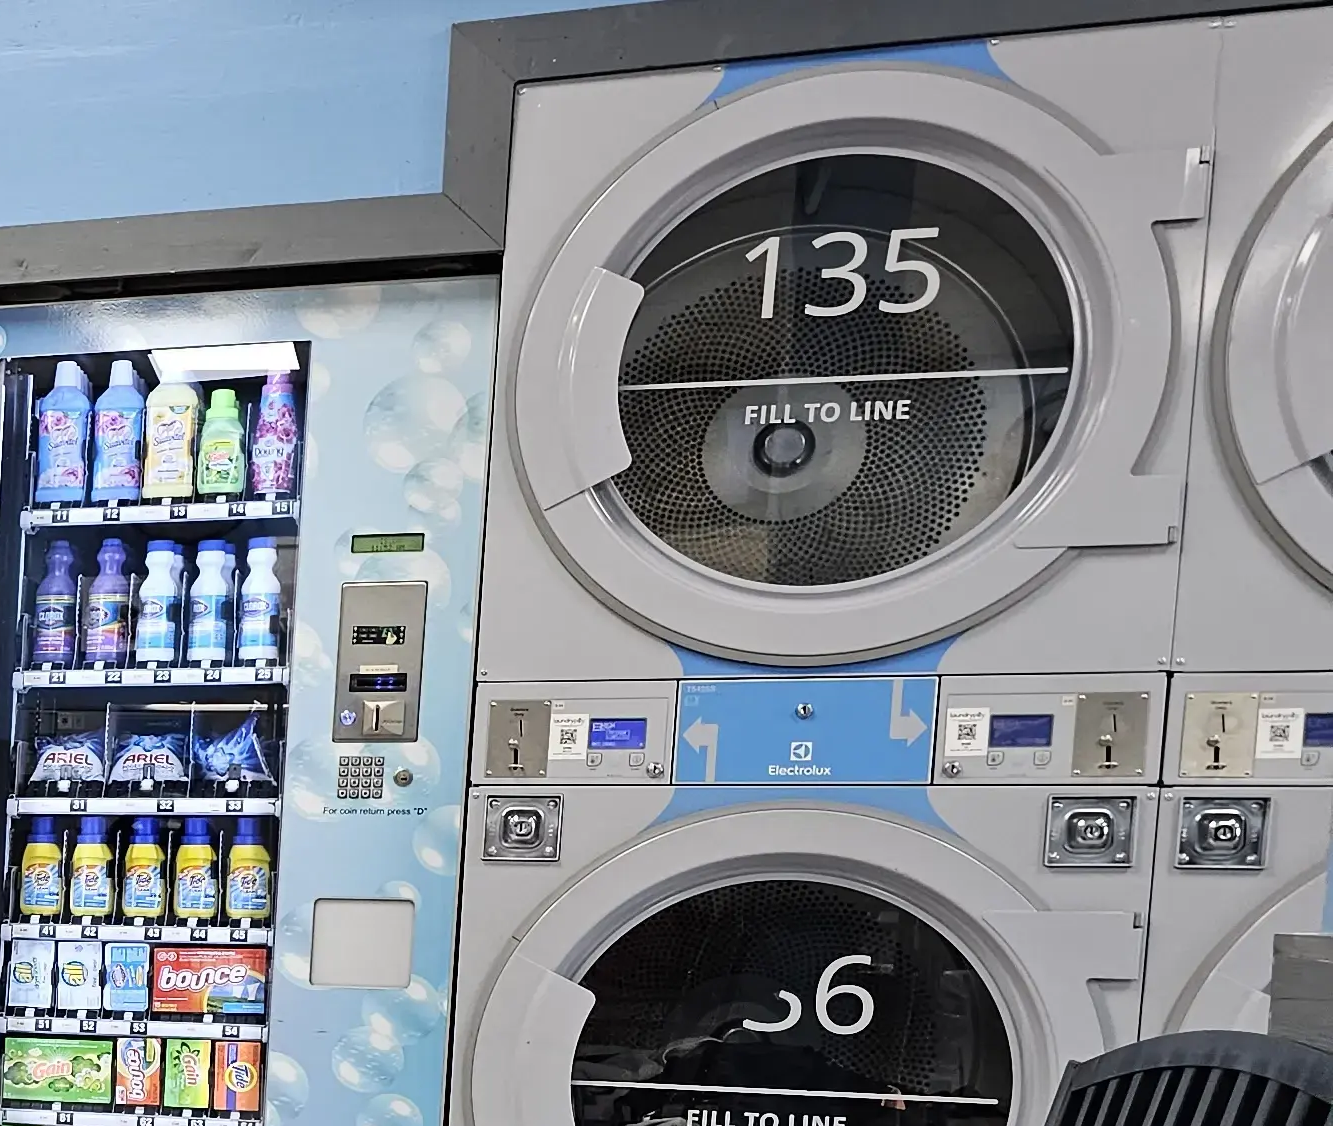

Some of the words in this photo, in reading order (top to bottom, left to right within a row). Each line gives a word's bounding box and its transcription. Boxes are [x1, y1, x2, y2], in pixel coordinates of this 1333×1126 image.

[744, 227, 942, 319] 135
[744, 403, 797, 425] FILL
[804, 402, 841, 423] TO
[850, 400, 912, 421] LINE
[173, 507, 186, 518] 13
[231, 505, 245, 516] 14
[274, 502, 288, 513] 15
[55, 511, 68, 521] 11
[105, 509, 119, 519] 12
[51, 672, 64, 682] 21
[107, 671, 121, 682] 22
[157, 670, 170, 681] 23
[206, 669, 220, 680] 24
[257, 669, 271, 679] 25
[43, 752, 94, 766] ARIEL
[122, 753, 175, 766] ARIEL
[767, 763, 832, 776] Electrolux
[72, 801, 85, 810] 31
[159, 801, 173, 810] 32
[228, 801, 242, 810] 33
[322, 806, 338, 815] For
[339, 807, 358, 815] coin
[359, 807, 385, 815] return
[387, 807, 411, 816] press
[413, 807, 428, 816] "D"
[41, 926, 54, 936] 41
[83, 927, 97, 937] 42
[146, 928, 160, 938] 43
[192, 929, 206, 939] 44
[232, 930, 246, 940] 45
[159, 964, 248, 992] bounce
[37, 1019, 50, 1029] 51
[82, 1021, 95, 1031] 52
[132, 1022, 146, 1033] 53
[224, 1026, 238, 1036] 54
[33, 1060, 73, 1080] Gain
[126, 1047, 147, 1101] bounce
[181, 1052, 201, 1086] Gain
[231, 1063, 249, 1089] Tide
